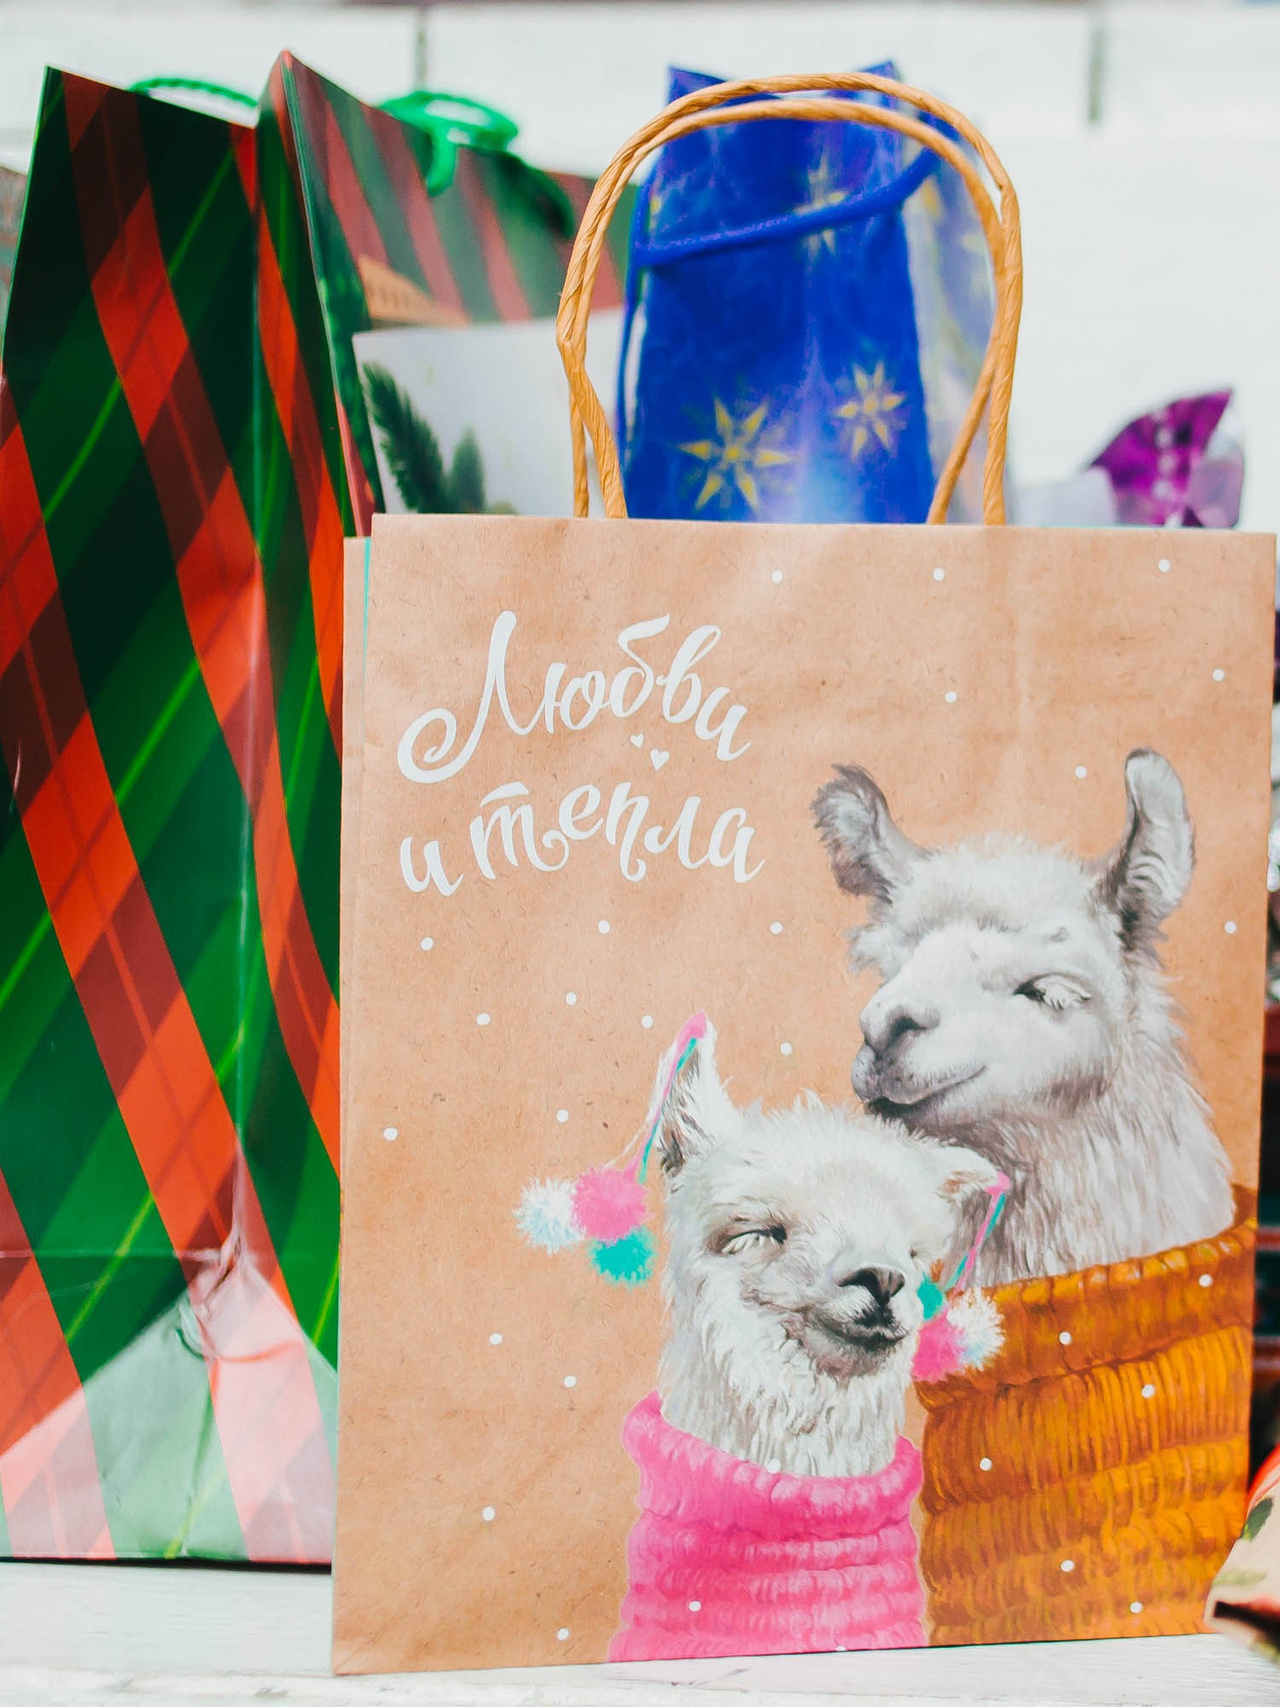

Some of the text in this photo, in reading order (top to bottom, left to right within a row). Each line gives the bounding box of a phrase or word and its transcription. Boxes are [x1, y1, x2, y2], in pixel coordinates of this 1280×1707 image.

[396, 609, 752, 785] Любви
[398, 780, 767, 897] и тепла
